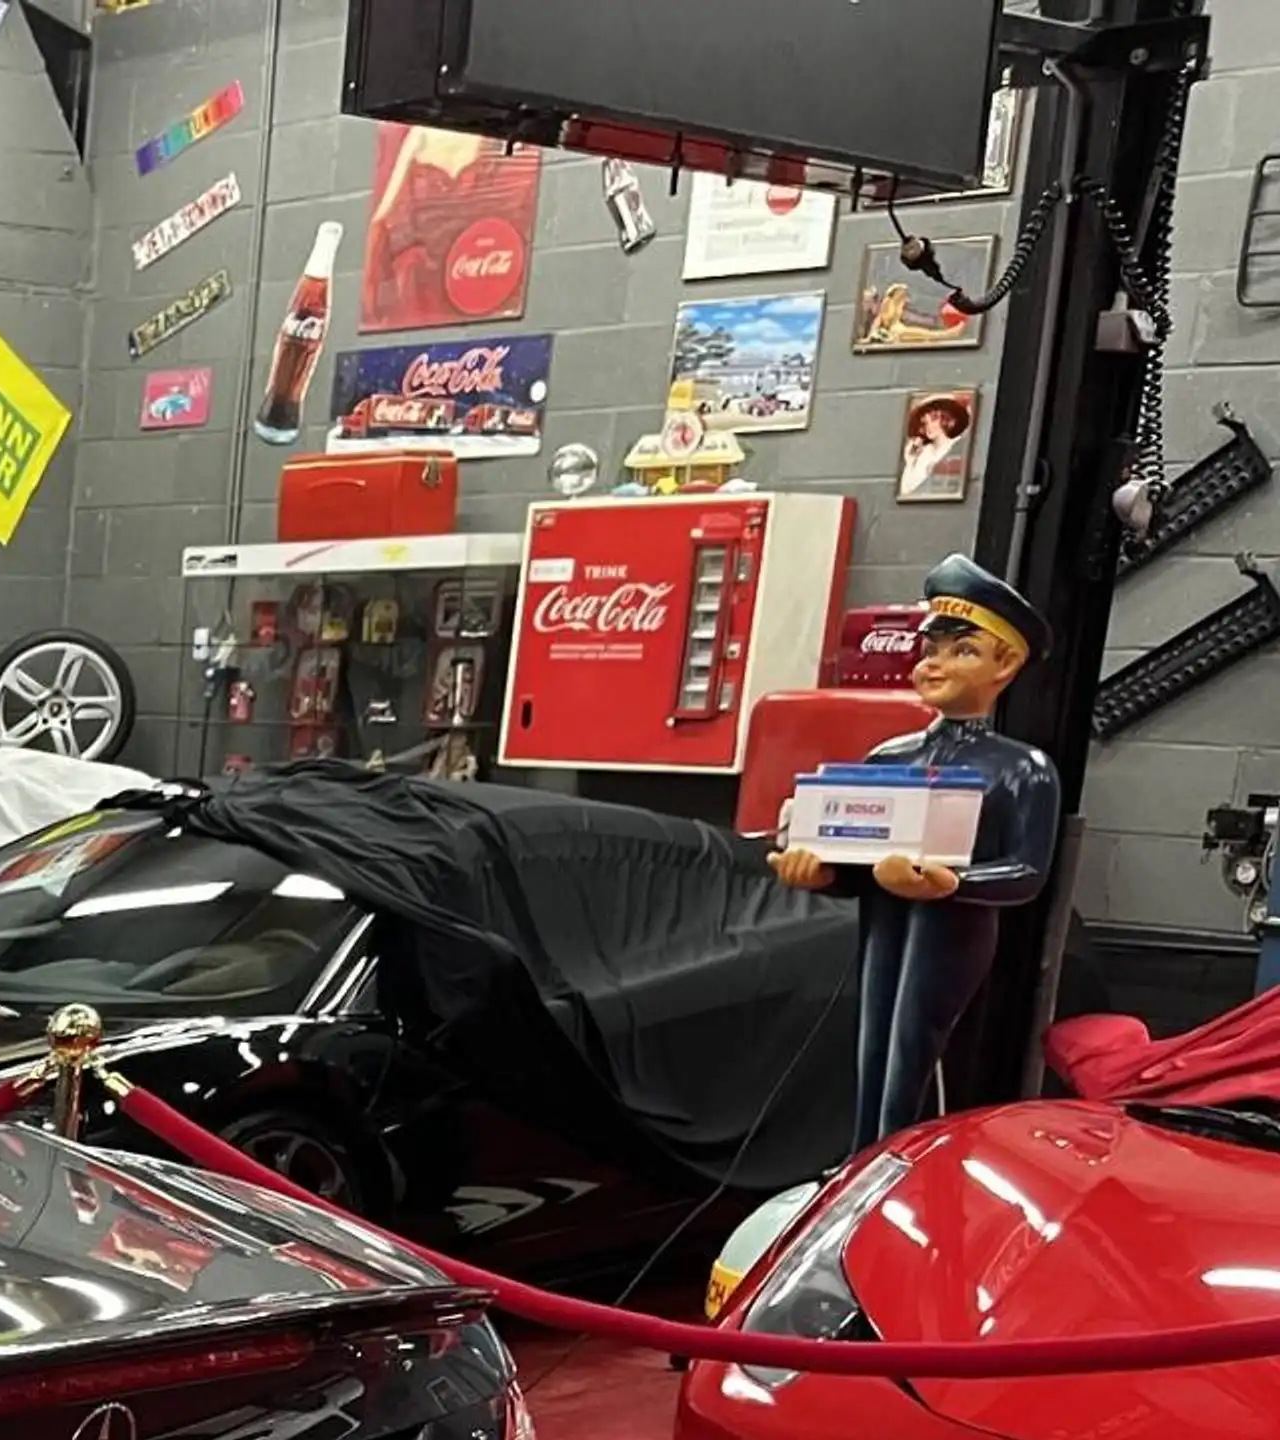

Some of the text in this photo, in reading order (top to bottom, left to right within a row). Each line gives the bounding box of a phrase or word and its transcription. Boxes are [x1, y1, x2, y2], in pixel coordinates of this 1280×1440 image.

[402, 346, 510, 398] Coca-Cola
[533, 582, 675, 633] Coca-Cola
[845, 804, 886, 816] BOSCH
